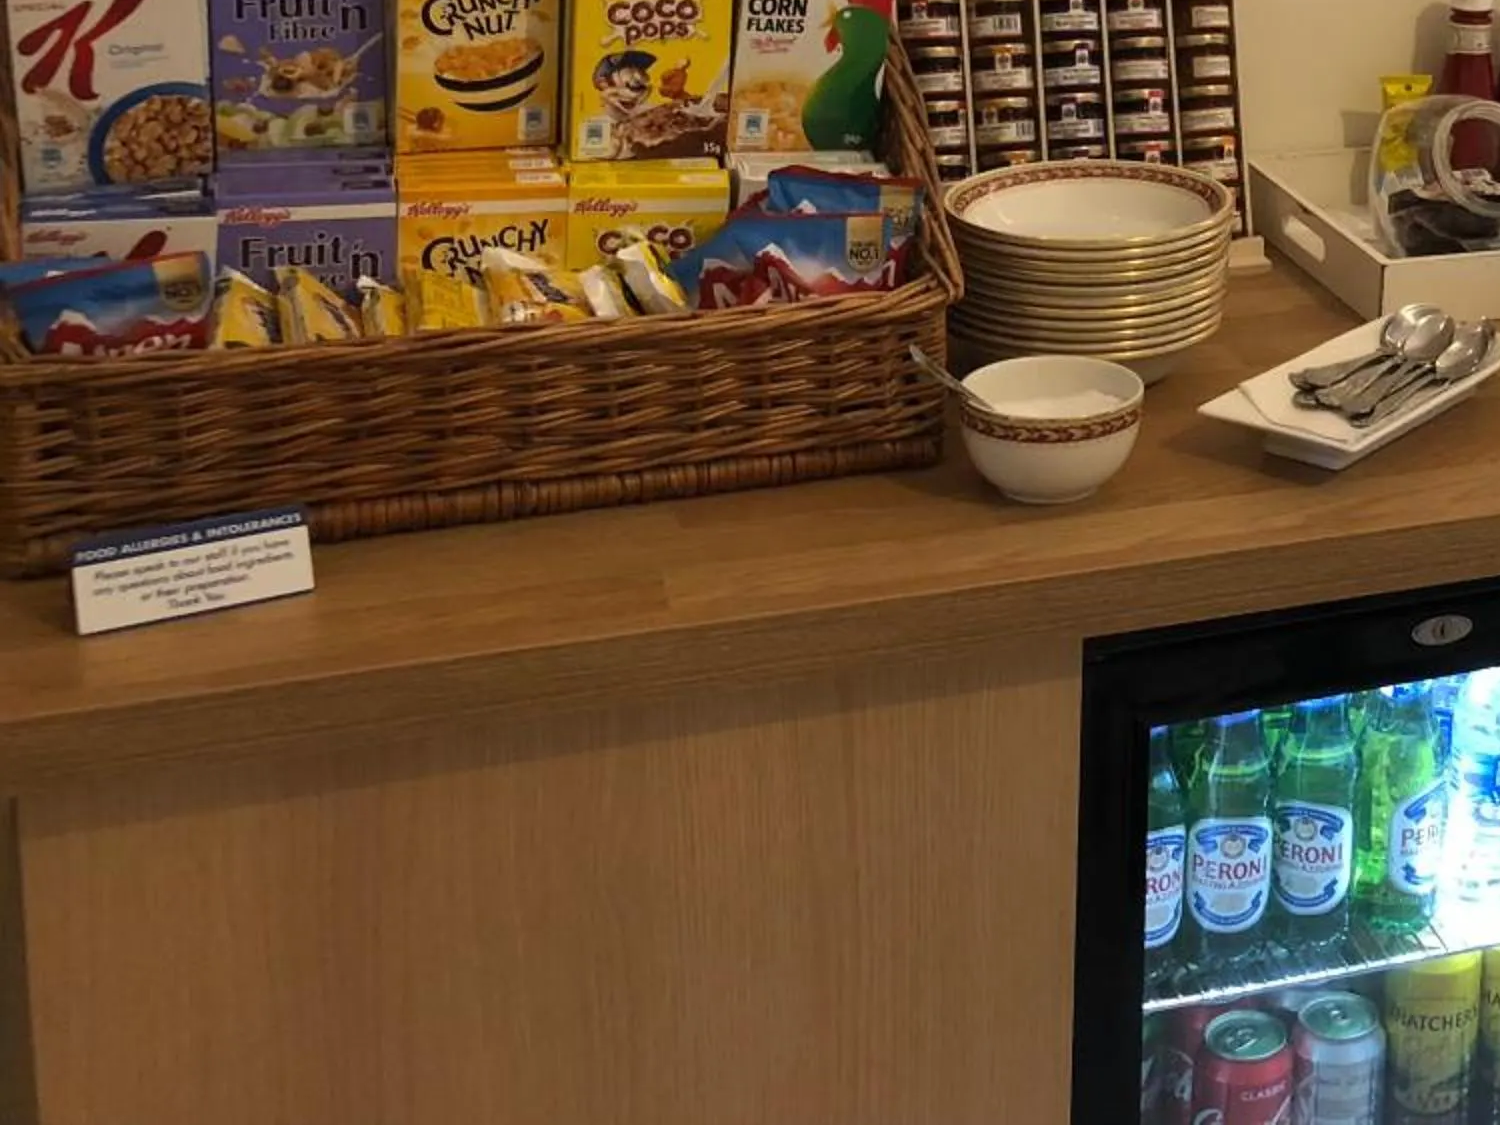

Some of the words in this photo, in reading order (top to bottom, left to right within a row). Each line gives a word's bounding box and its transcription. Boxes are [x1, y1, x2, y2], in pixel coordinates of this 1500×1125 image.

[269, 21, 336, 43] Fibre
[463, 9, 520, 41] NUT
[746, 17, 804, 33] FLAKES
[239, 232, 343, 269] Fruit
[597, 224, 696, 256] CCO
[76, 546, 118, 562] FOOD
[121, 533, 189, 554] ALLERGIES
[206, 512, 302, 537] INTOLERANCES
[1401, 825, 1439, 849] PER
[1192, 852, 1268, 880] PERONI
[1146, 869, 1182, 894] RON
